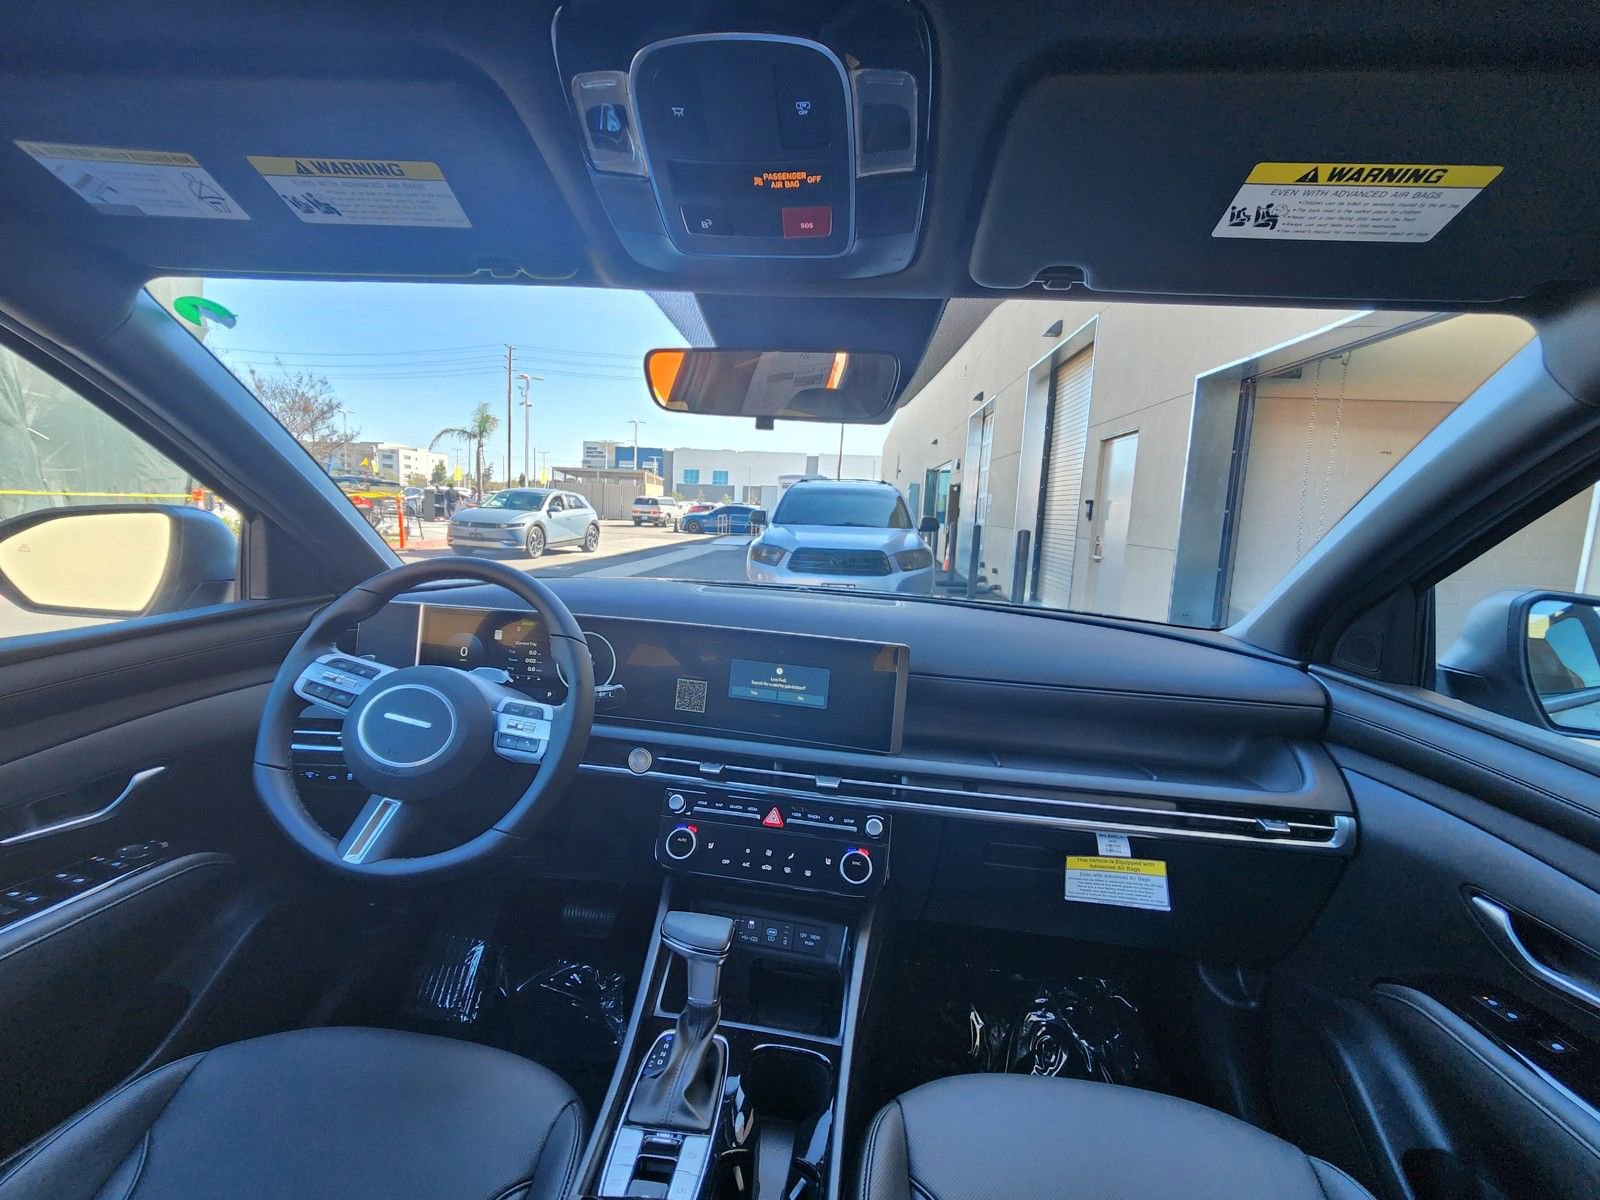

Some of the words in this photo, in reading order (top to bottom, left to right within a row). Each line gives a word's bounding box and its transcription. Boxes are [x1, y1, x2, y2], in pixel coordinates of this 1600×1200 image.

[309, 160, 405, 177] WARNING
[763, 171, 807, 181] PASSENGER
[807, 175, 822, 184] OFF
[1326, 166, 1448, 184] WARNING
[770, 181, 783, 189] AIR
[784, 180, 800, 188] BAG
[1270, 188, 1298, 197] EVEN
[1302, 189, 1328, 197] WITH
[1332, 189, 1388, 198] ADVANCED
[1391, 191, 1410, 199] AIR
[1411, 191, 1444, 200] BAGS
[460, 646, 468, 657] 0
[1115, 859, 1142, 867] Equipped
